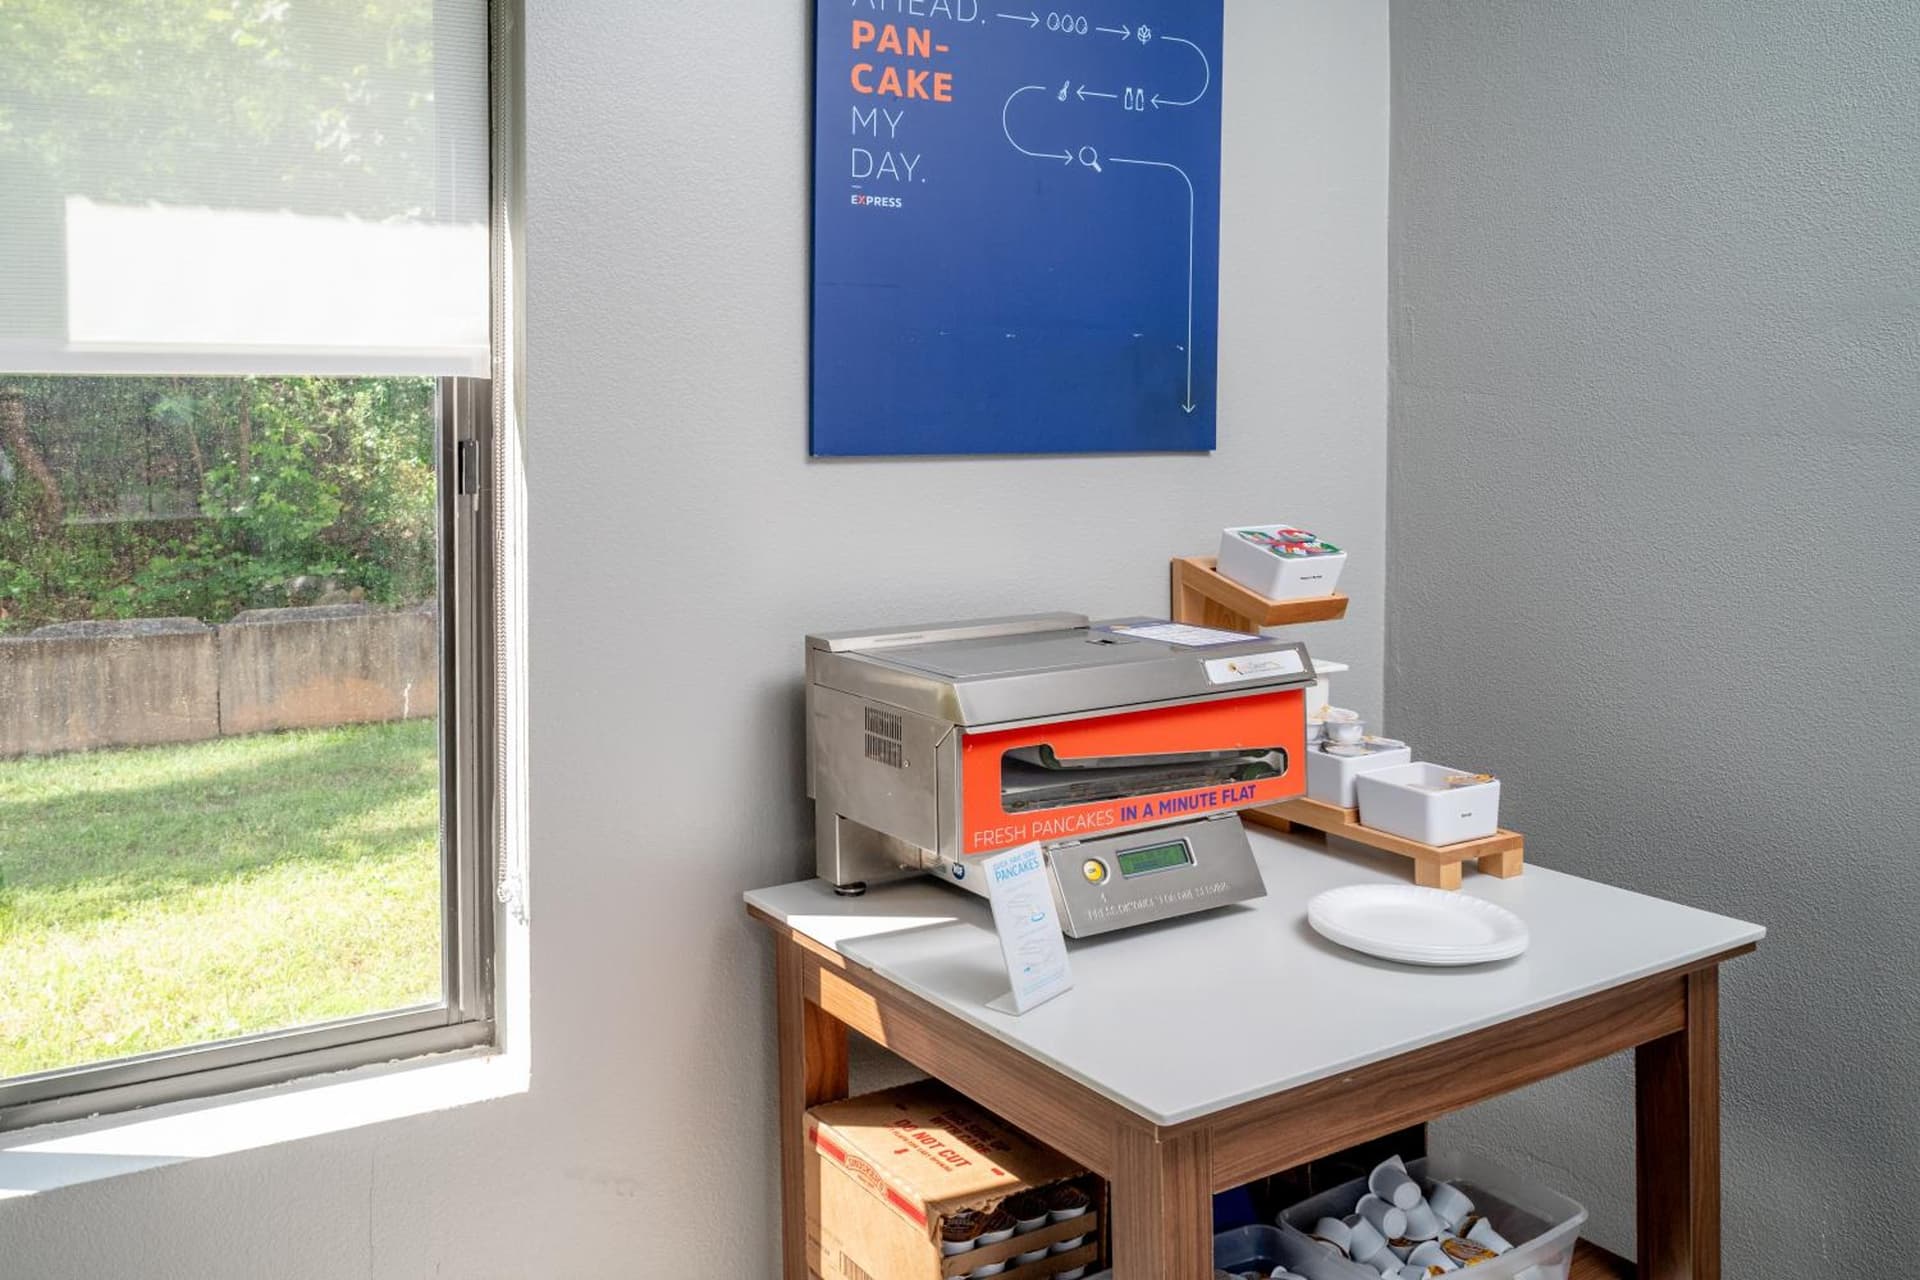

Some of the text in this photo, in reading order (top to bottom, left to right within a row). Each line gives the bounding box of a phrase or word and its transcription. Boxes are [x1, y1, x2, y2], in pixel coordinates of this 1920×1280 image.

[852, 0, 986, 24] EAD.
[852, 20, 949, 58] PAN-
[850, 63, 952, 102] CAKE
[852, 105, 904, 139] MY
[852, 148, 926, 182] DAY.
[851, 194, 902, 208] EXPRESS
[973, 785, 1256, 848] FRESH PANCAKES IN A MINUTE FLAT
[995, 859, 1039, 882] PANCAKES
[893, 1119, 972, 1168] DO NOT CUT
